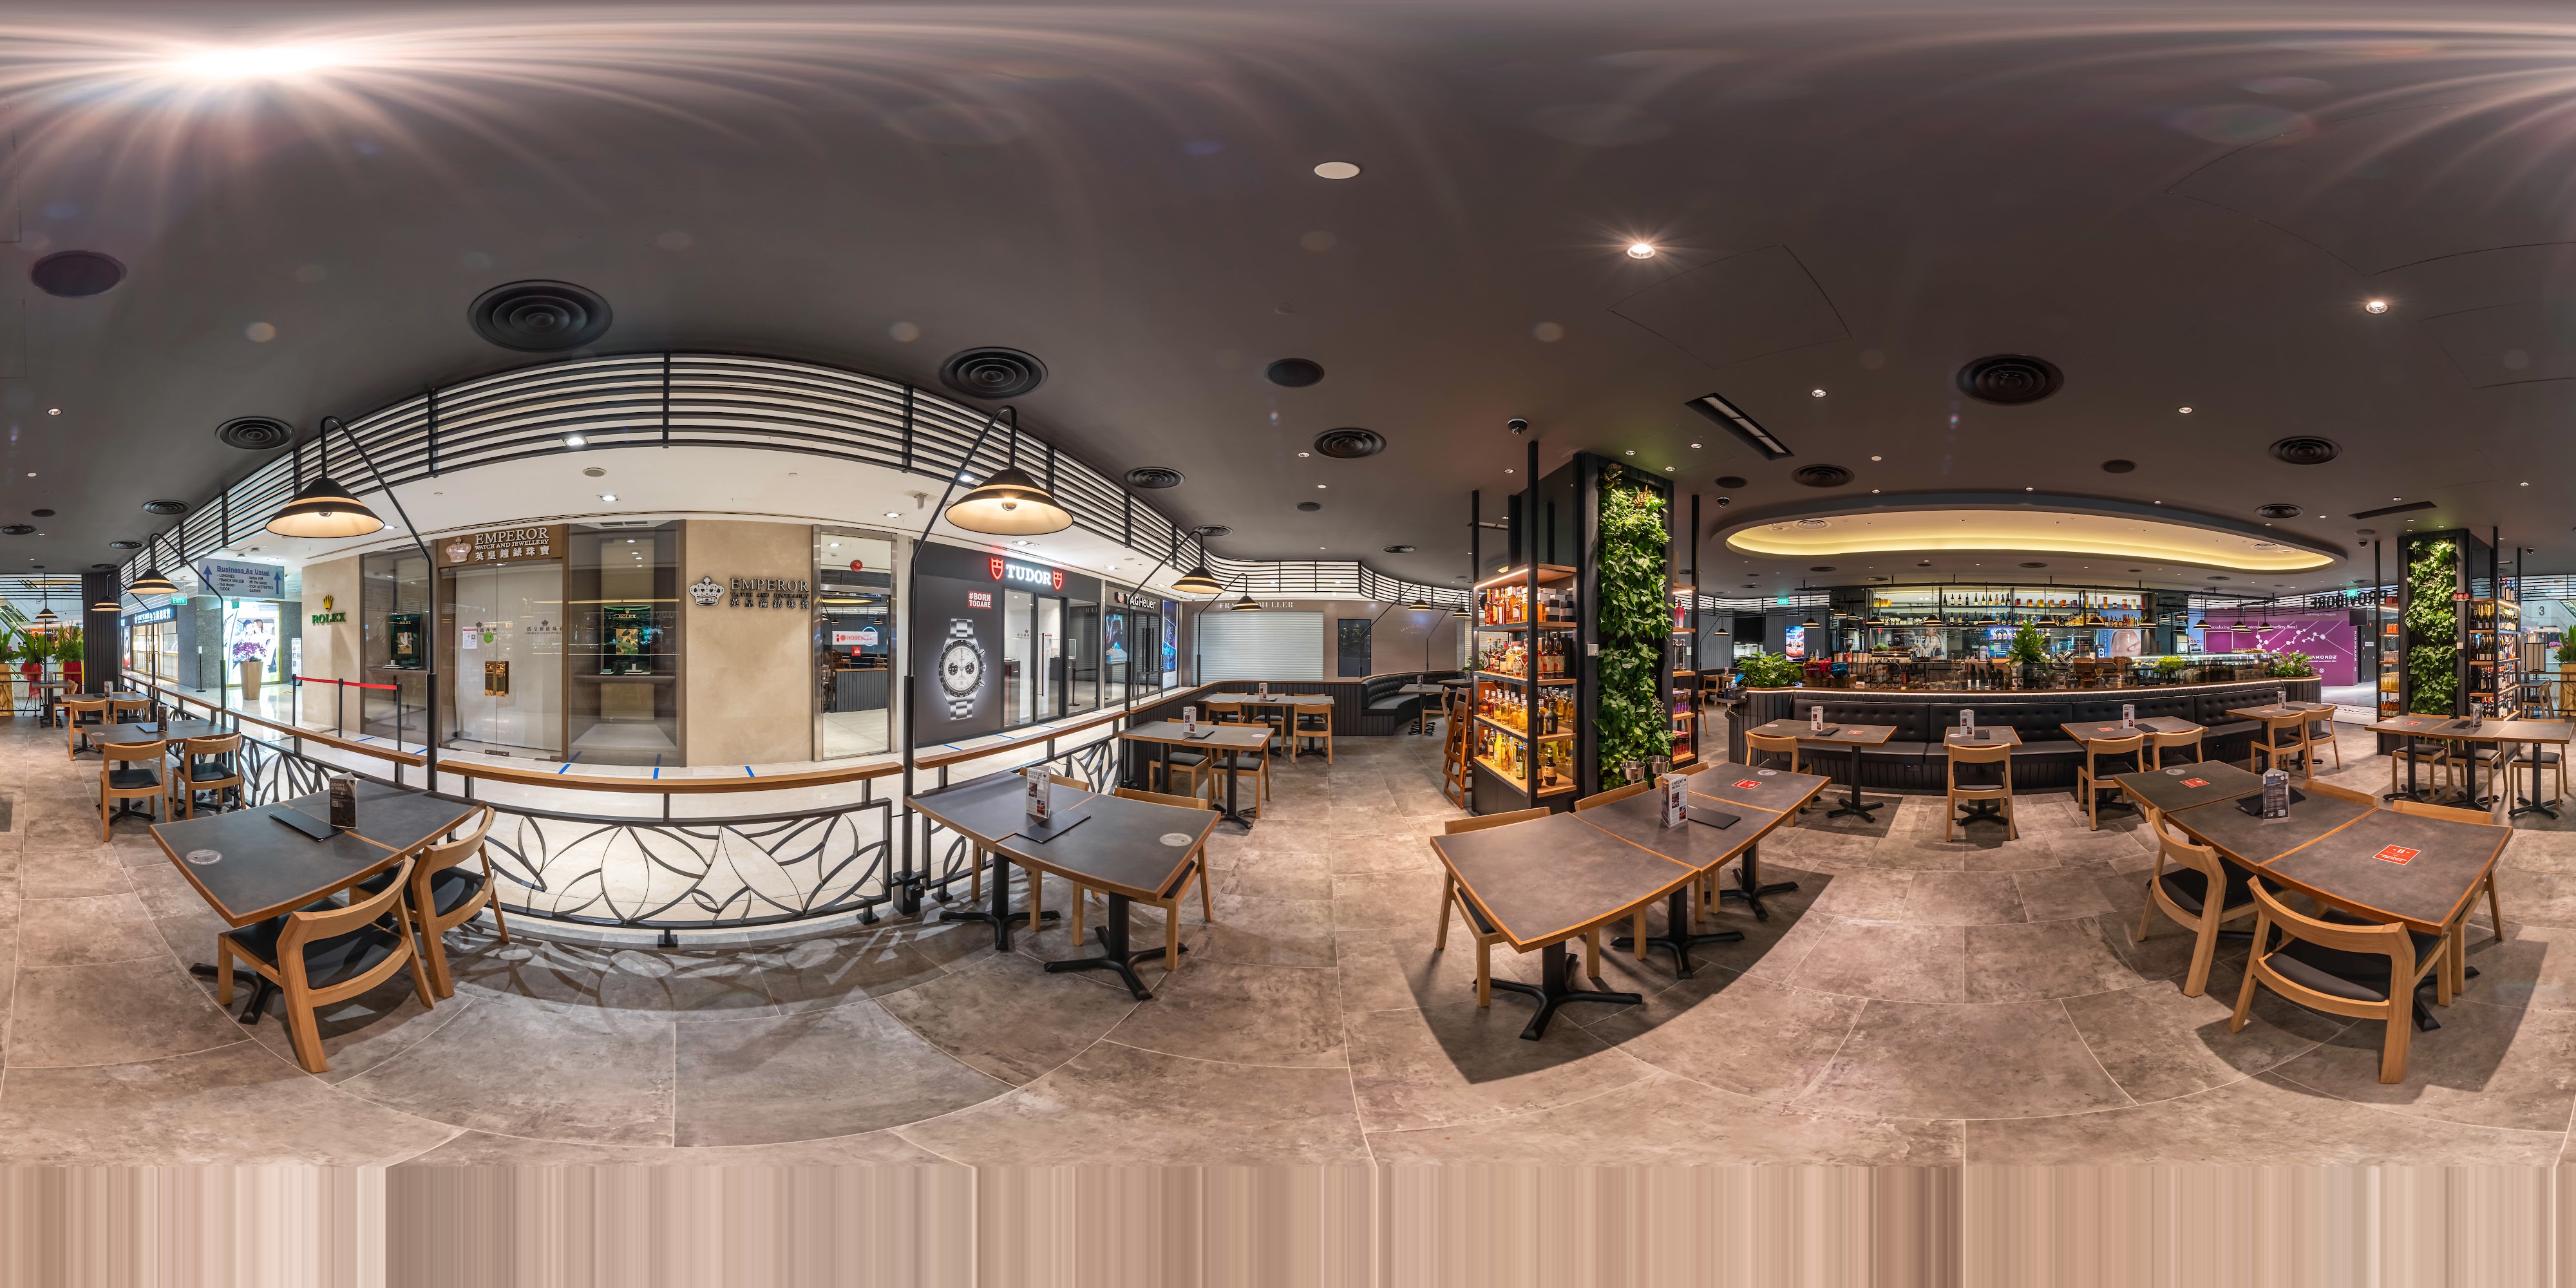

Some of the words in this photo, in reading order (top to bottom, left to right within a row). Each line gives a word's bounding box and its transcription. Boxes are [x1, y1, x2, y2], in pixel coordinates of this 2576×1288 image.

[475, 527, 549, 545] EMPEROR
[1006, 564, 1051, 585] TUDOR
[730, 578, 810, 592] EMPEROR
[969, 592, 990, 601] #BORN
[2539, 606, 2544, 616] 3
[311, 612, 346, 624] ROLEX
